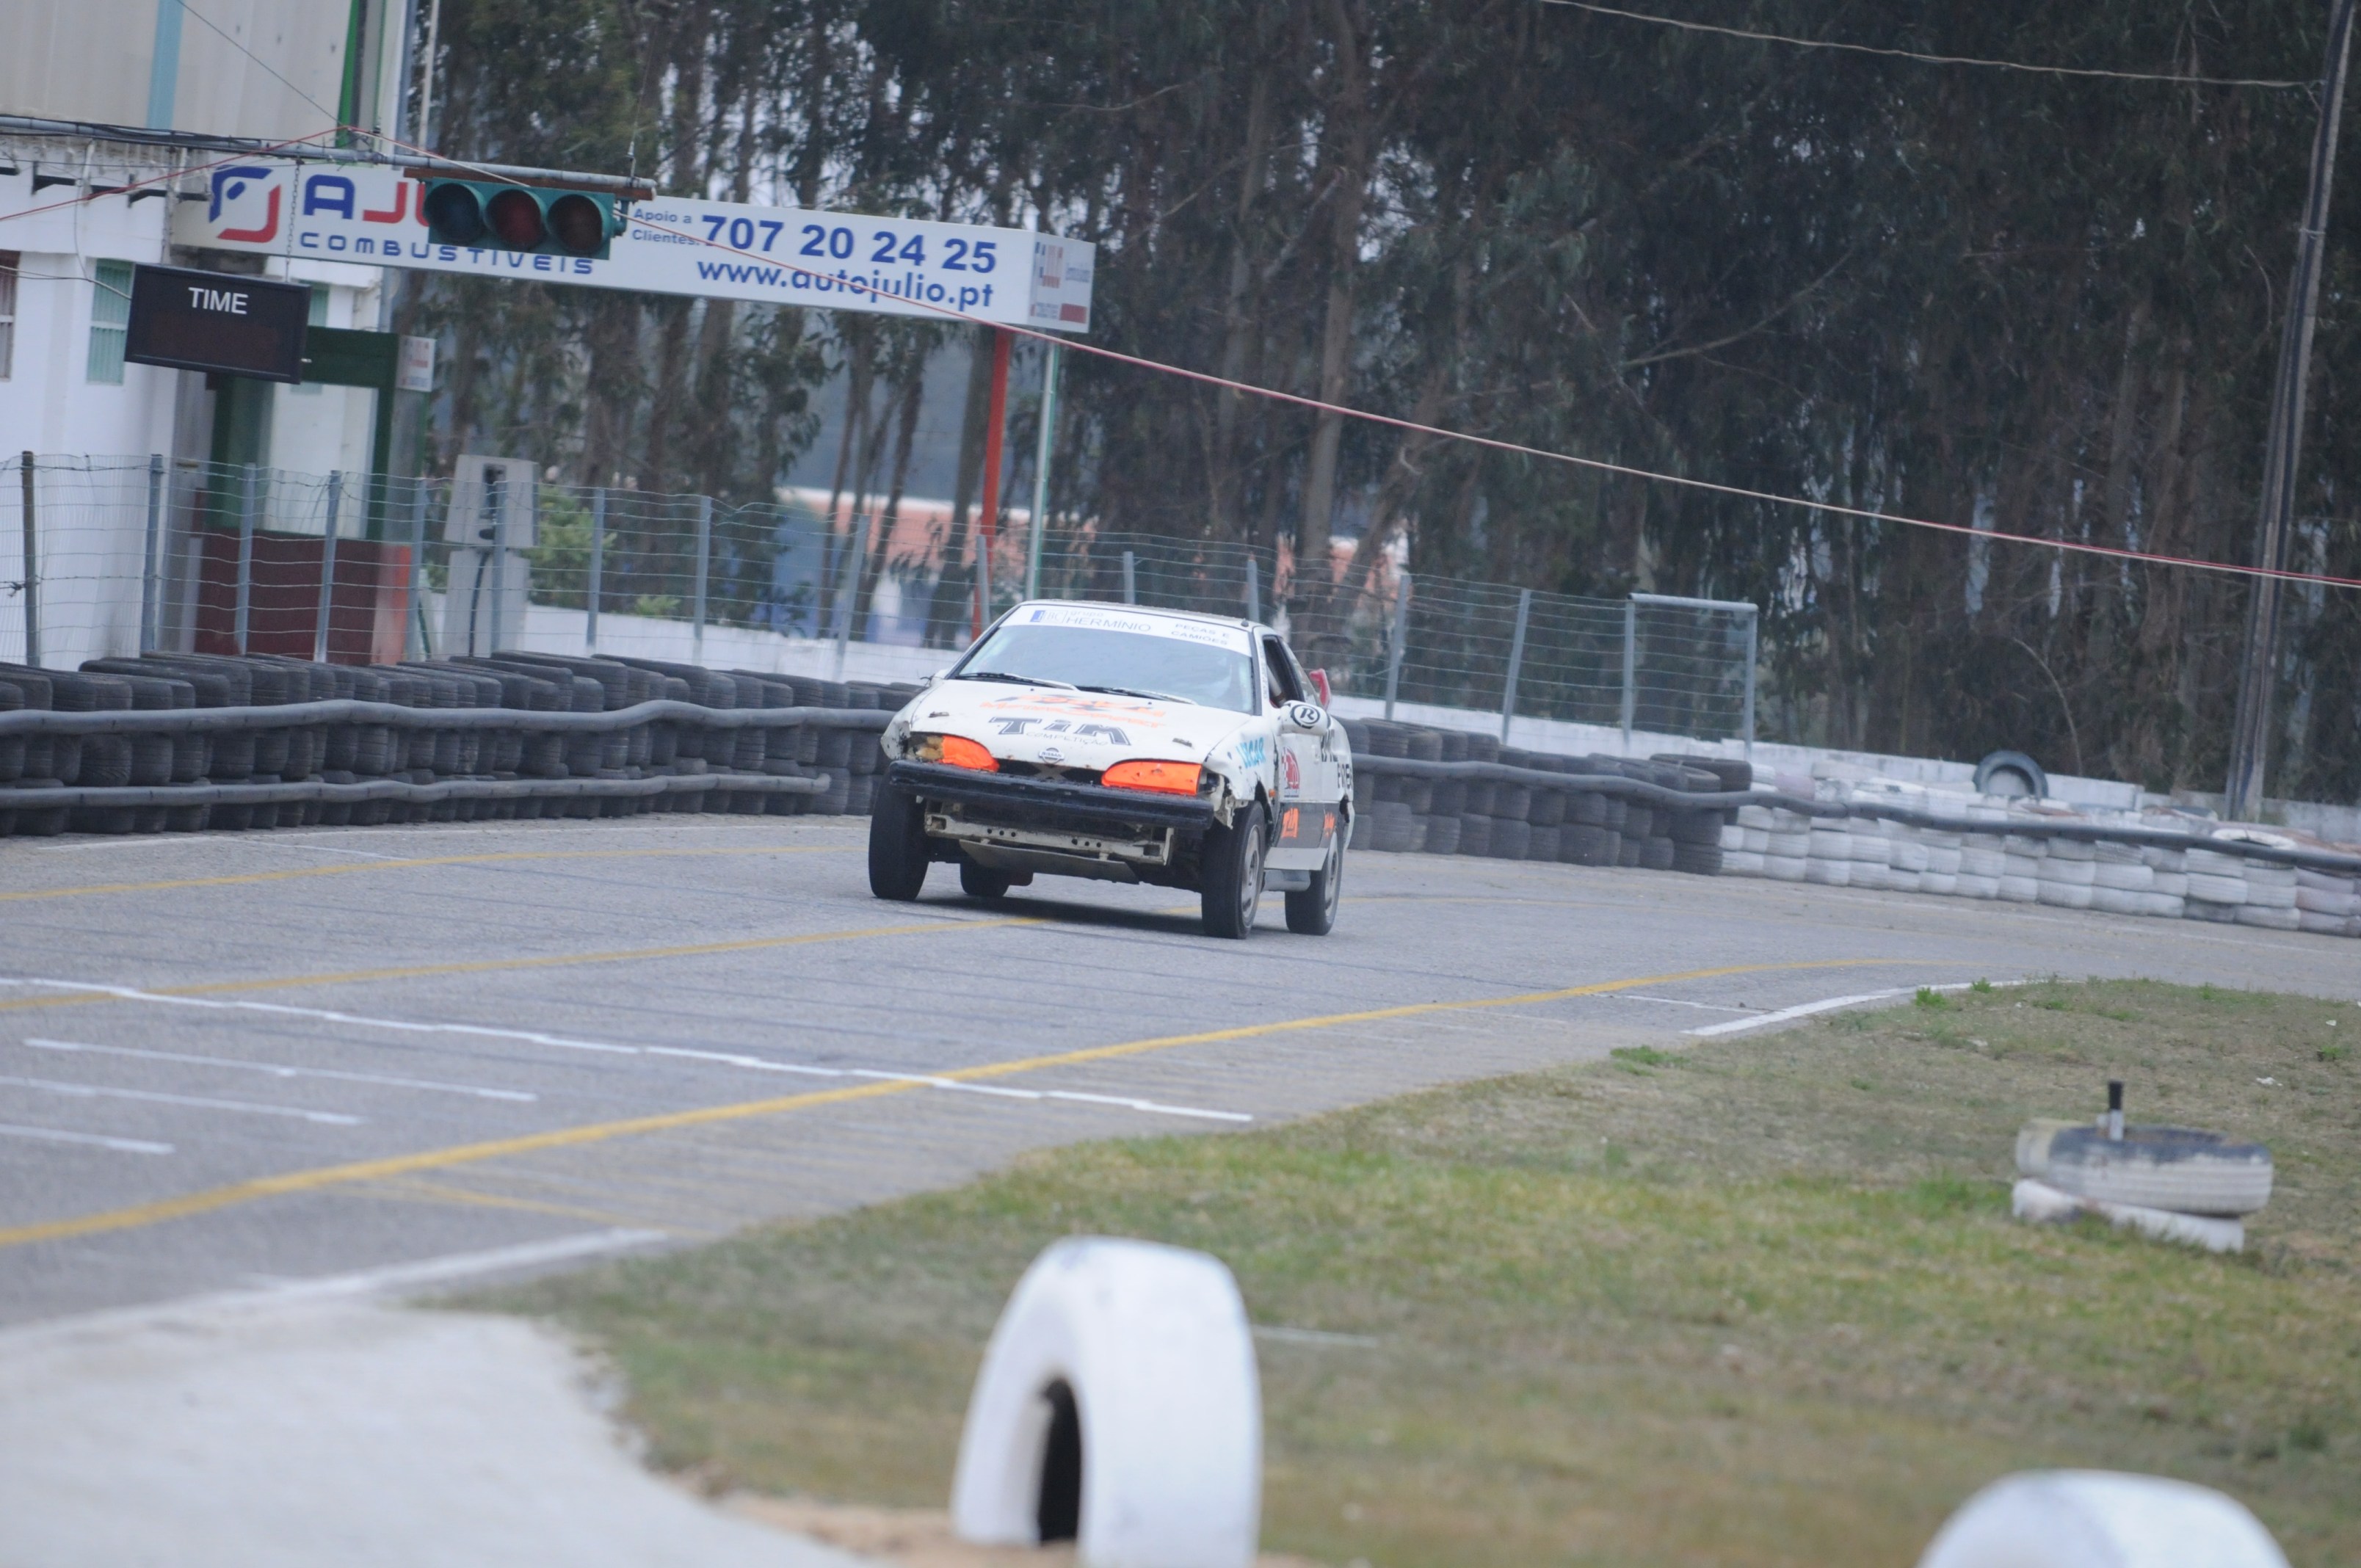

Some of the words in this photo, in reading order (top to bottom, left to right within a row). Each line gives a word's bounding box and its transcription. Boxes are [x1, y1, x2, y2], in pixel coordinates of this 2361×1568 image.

[634, 208, 678, 223] Apoio
[683, 215, 692, 224] a
[702, 214, 784, 252] 707
[800, 225, 855, 260] 20
[871, 231, 926, 266] 24
[941, 238, 996, 274] 25
[697, 261, 993, 311] www.autojulio.pt
[188, 287, 248, 315] TIME
[1066, 617, 1151, 632] HERMÍNIO
